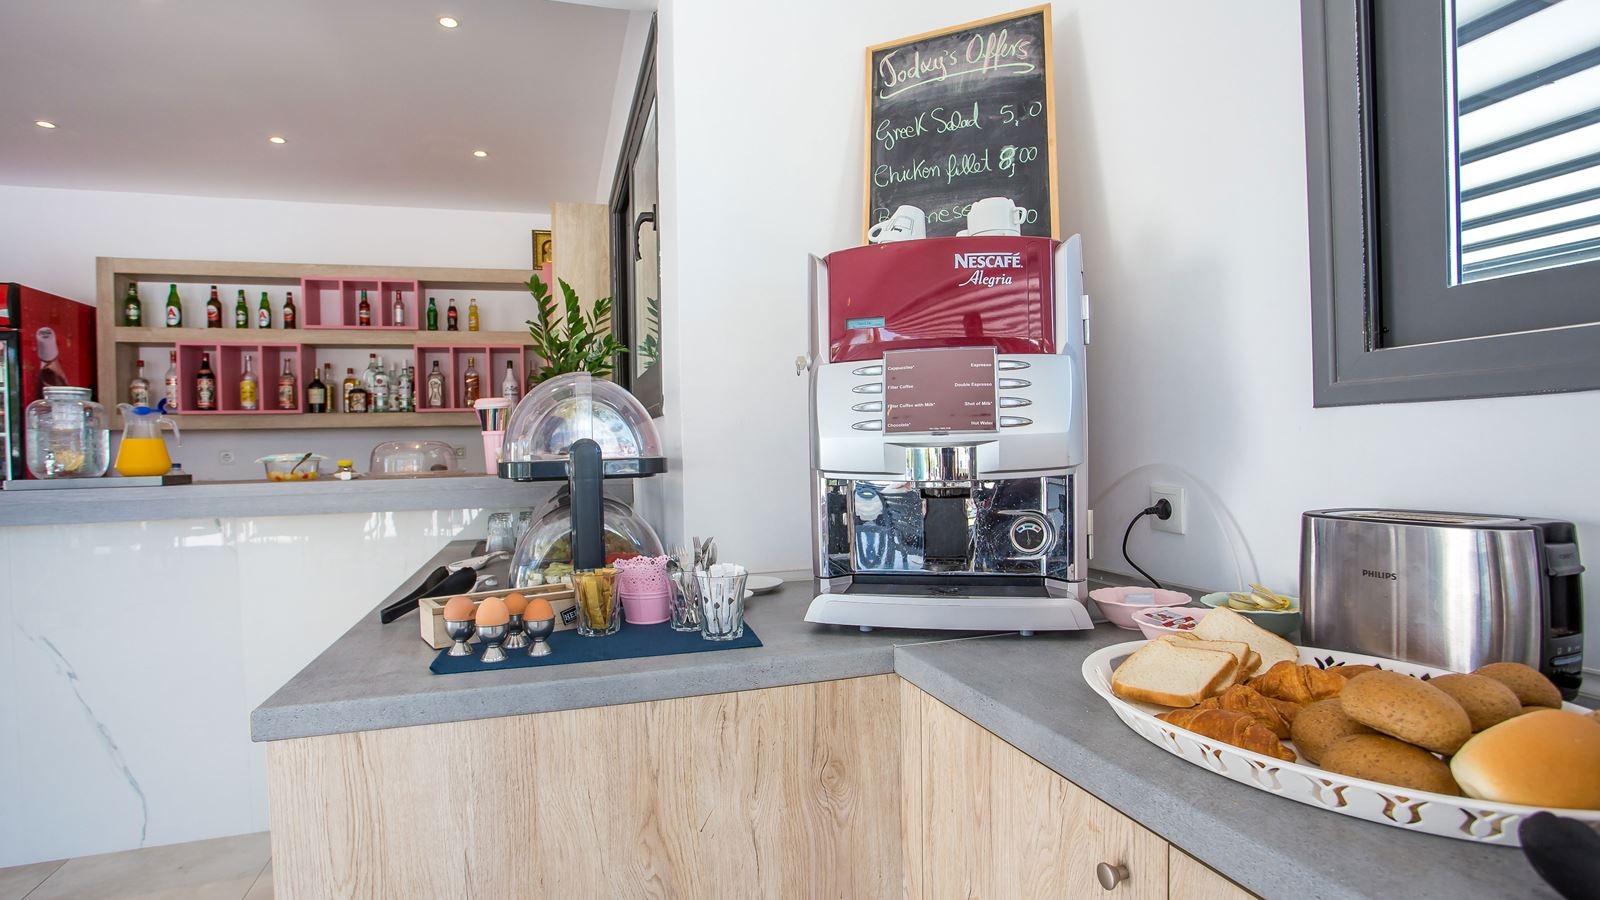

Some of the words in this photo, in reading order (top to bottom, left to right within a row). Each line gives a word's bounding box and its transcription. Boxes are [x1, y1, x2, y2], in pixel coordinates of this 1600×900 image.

[966, 29, 1031, 74] Offers
[930, 101, 983, 134] Salad
[958, 269, 1013, 288] Alegria
[1362, 569, 1397, 581] PHILIPS
